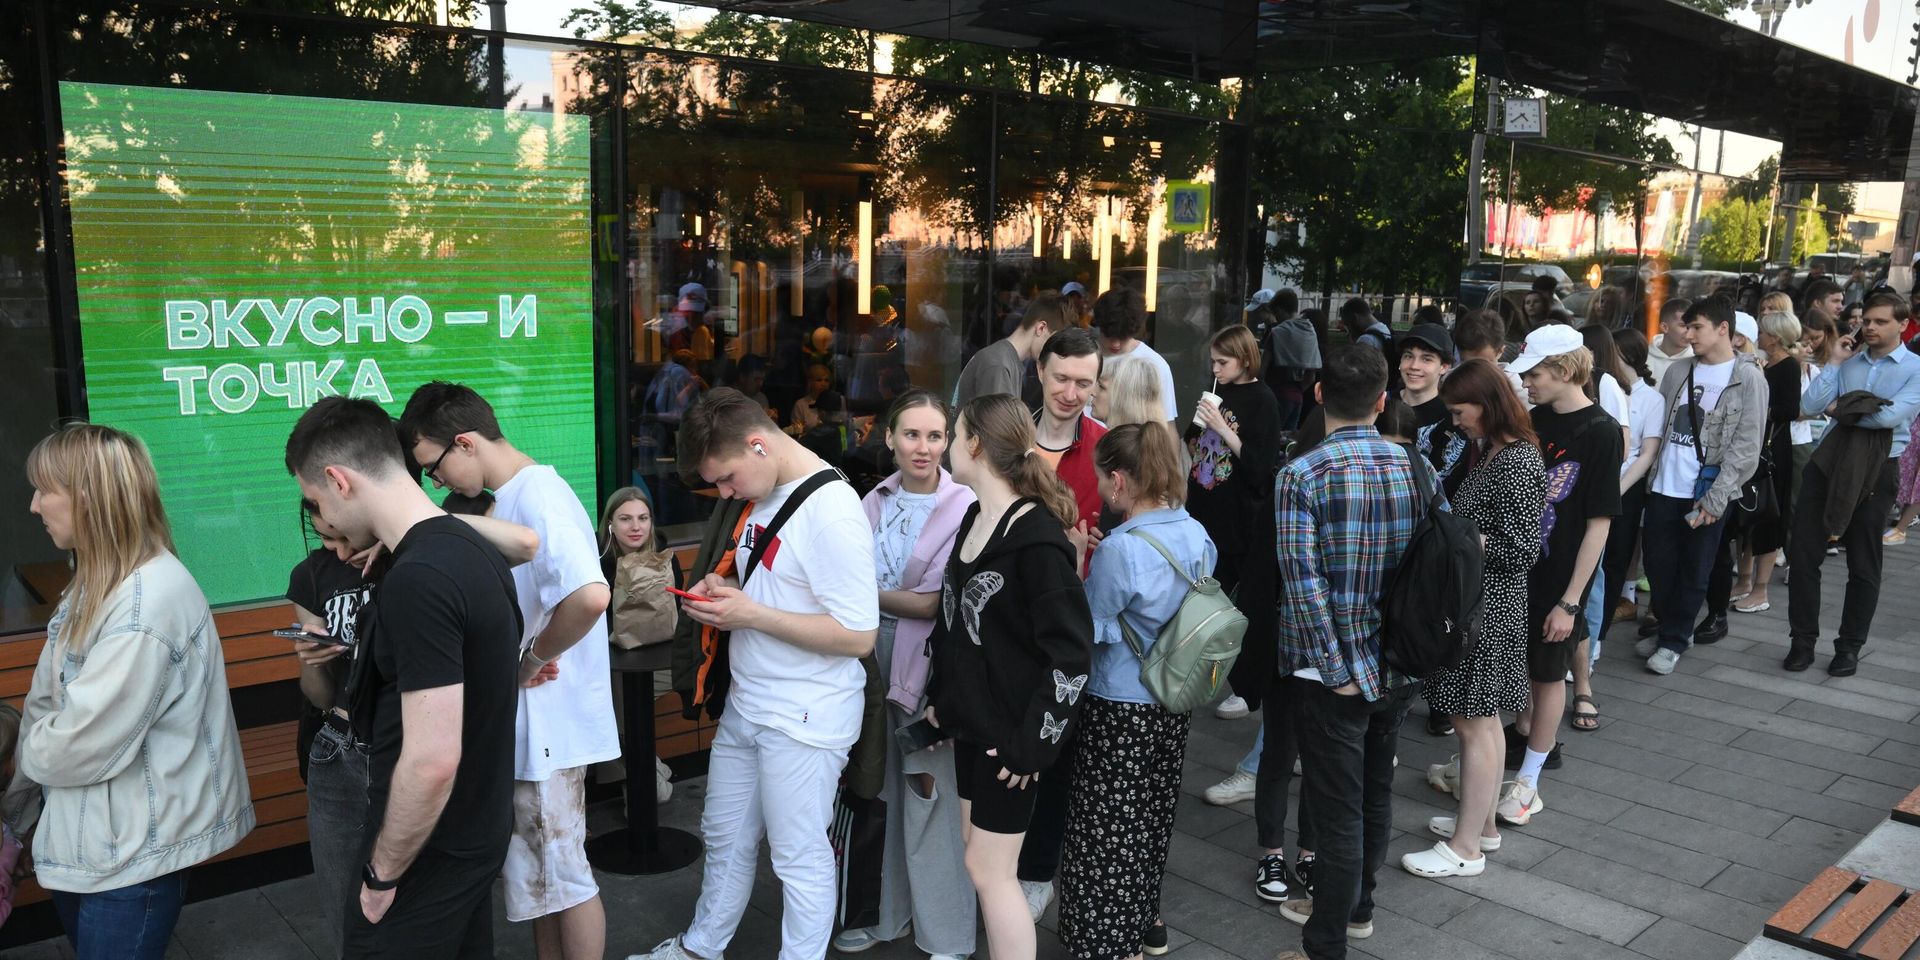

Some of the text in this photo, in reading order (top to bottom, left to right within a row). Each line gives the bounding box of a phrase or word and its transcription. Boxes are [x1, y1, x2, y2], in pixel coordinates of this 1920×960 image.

[165, 295, 433, 350] ВКУСНО
[498, 294, 538, 338] И
[162, 358, 394, 416] ТОЧКА
